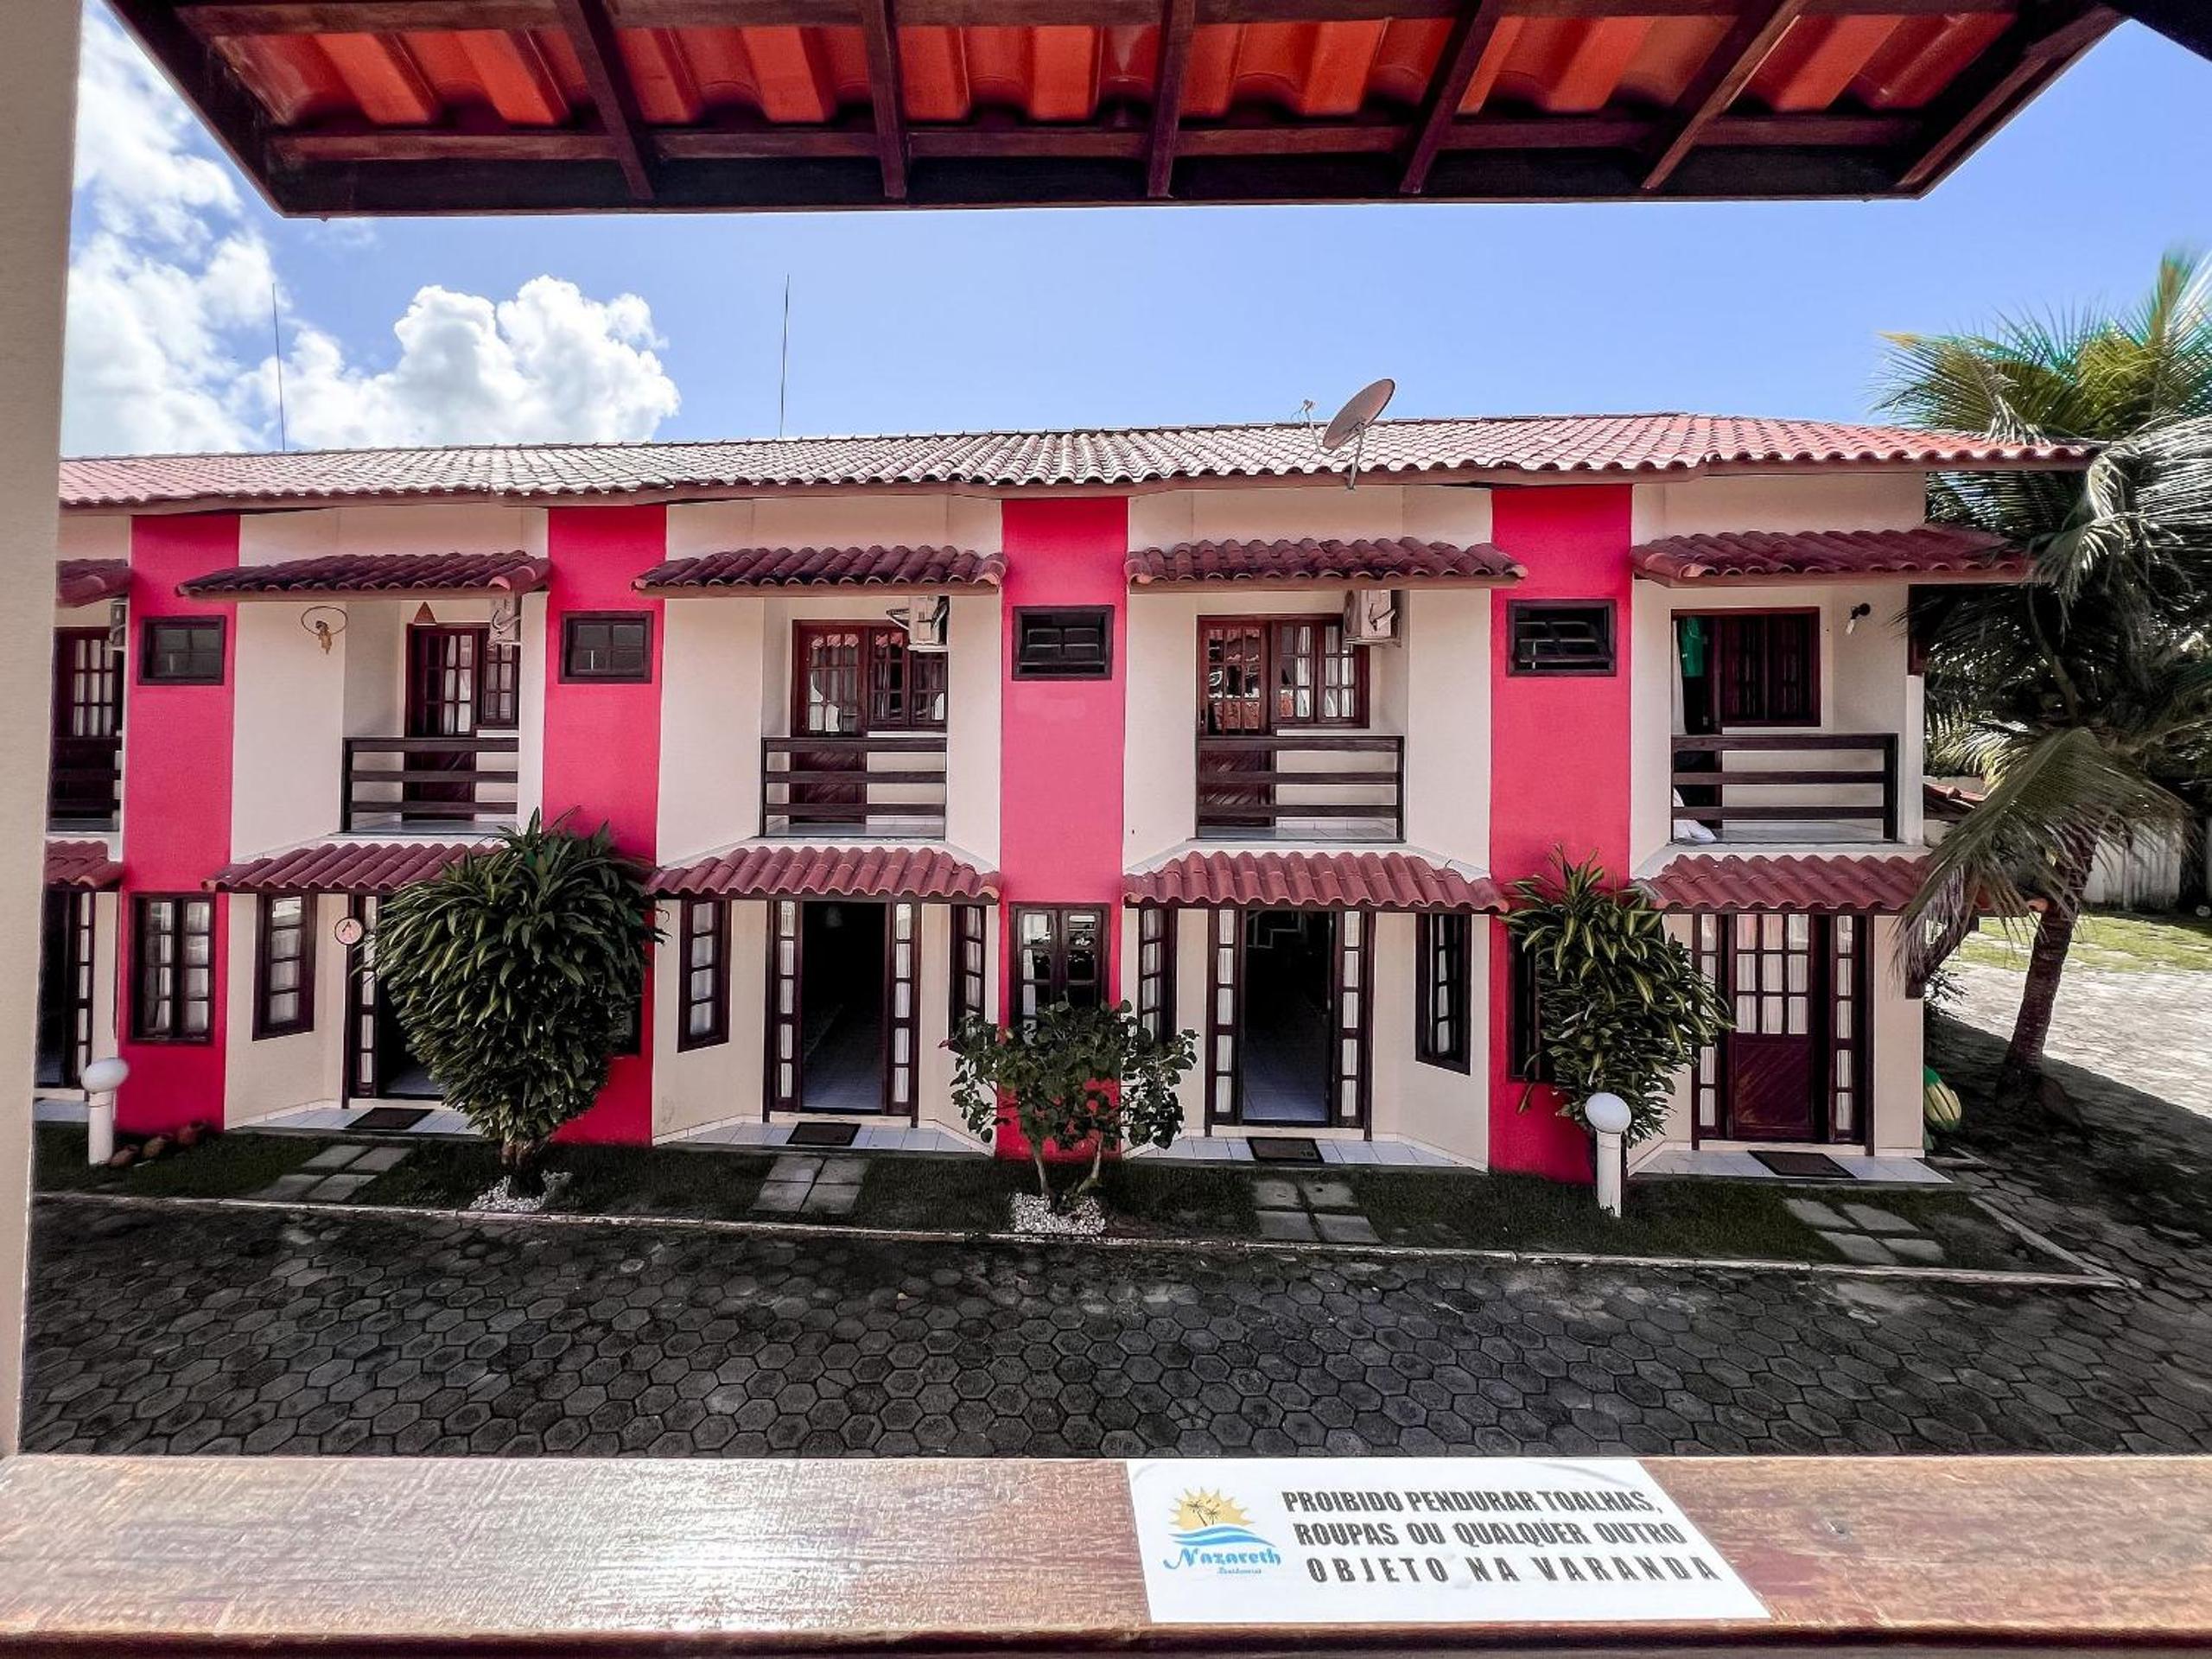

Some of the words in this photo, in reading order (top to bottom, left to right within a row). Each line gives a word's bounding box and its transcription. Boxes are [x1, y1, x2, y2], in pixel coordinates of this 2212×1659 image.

[1281, 1491, 1404, 1512] PROIBIDO
[1404, 1491, 1542, 1512] PENDURAR
[1536, 1491, 1663, 1514] TOALHAS,
[1293, 1522, 1400, 1546] ROUPAS
[1406, 1522, 1446, 1545] OU
[1452, 1522, 1592, 1548] QUALQUER
[1592, 1522, 1688, 1545] OUTRO
[1163, 1548, 1281, 1570] Nazareth
[1306, 1557, 1450, 1583] OBJETO
[1465, 1556, 1522, 1582] NA
[1529, 1556, 1723, 1582] VARANDA
